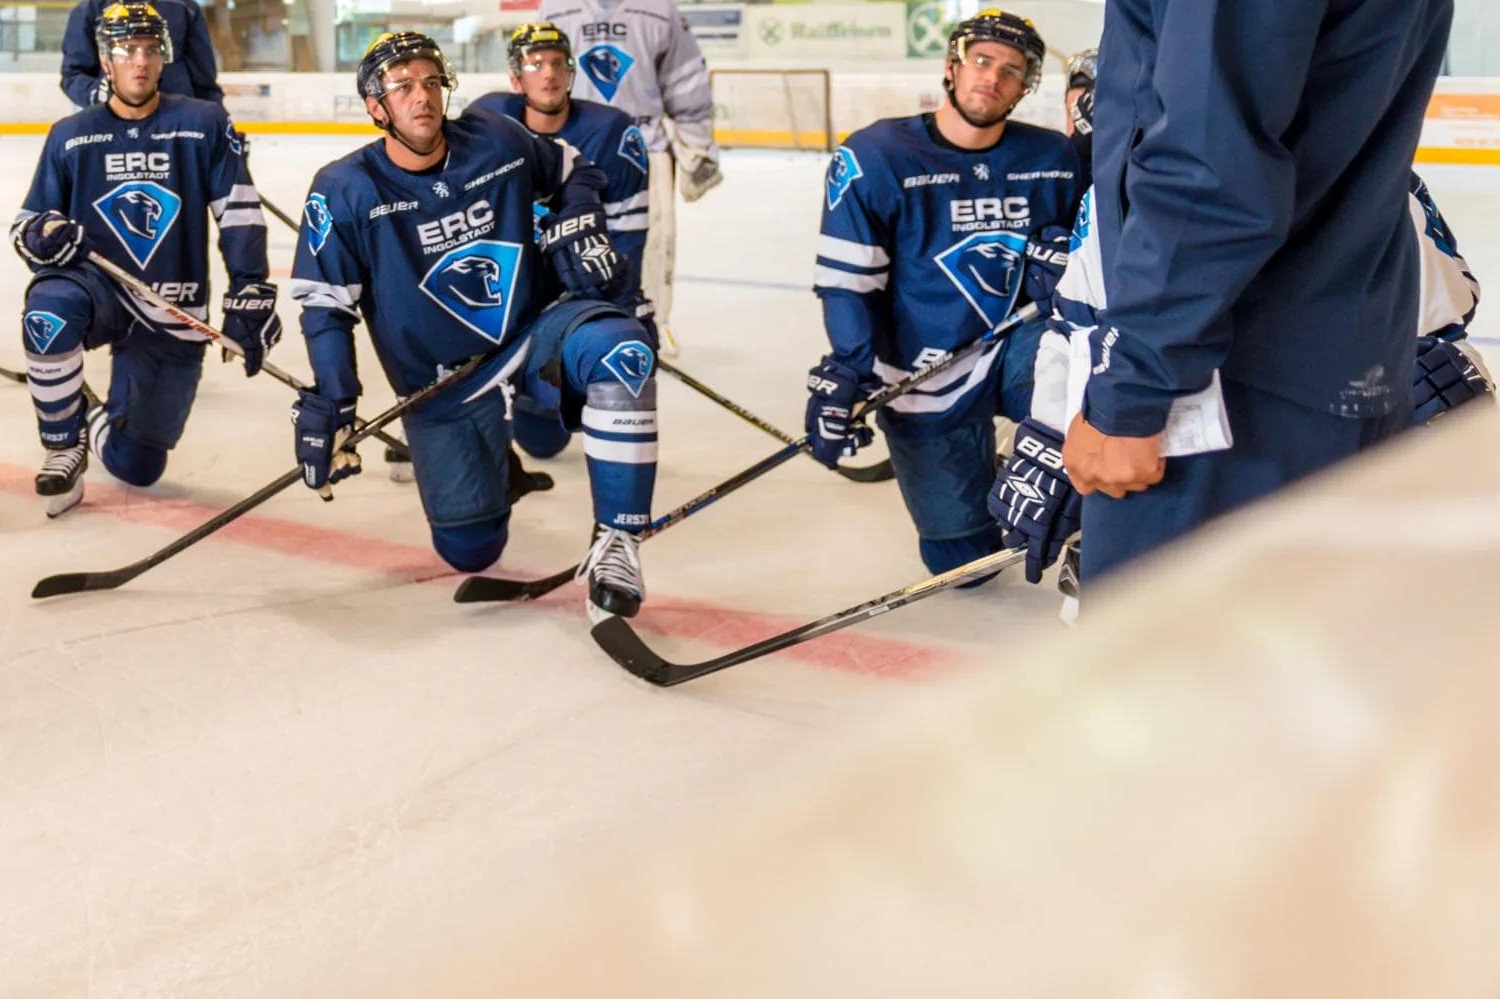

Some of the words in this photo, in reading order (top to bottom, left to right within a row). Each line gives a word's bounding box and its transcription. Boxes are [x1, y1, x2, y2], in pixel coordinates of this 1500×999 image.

[582, 22, 628, 36] ERC
[65, 133, 114, 150] BAUER
[105, 152, 170, 173] ERC
[106, 171, 170, 181] INGOLSTADT
[903, 173, 961, 190] BAUER
[369, 200, 419, 220] BAUER
[950, 196, 1031, 222] ERC
[417, 200, 495, 246] ERC
[952, 217, 1031, 232] INGOLSTADT
[422, 221, 496, 255] INGOLSTADT
